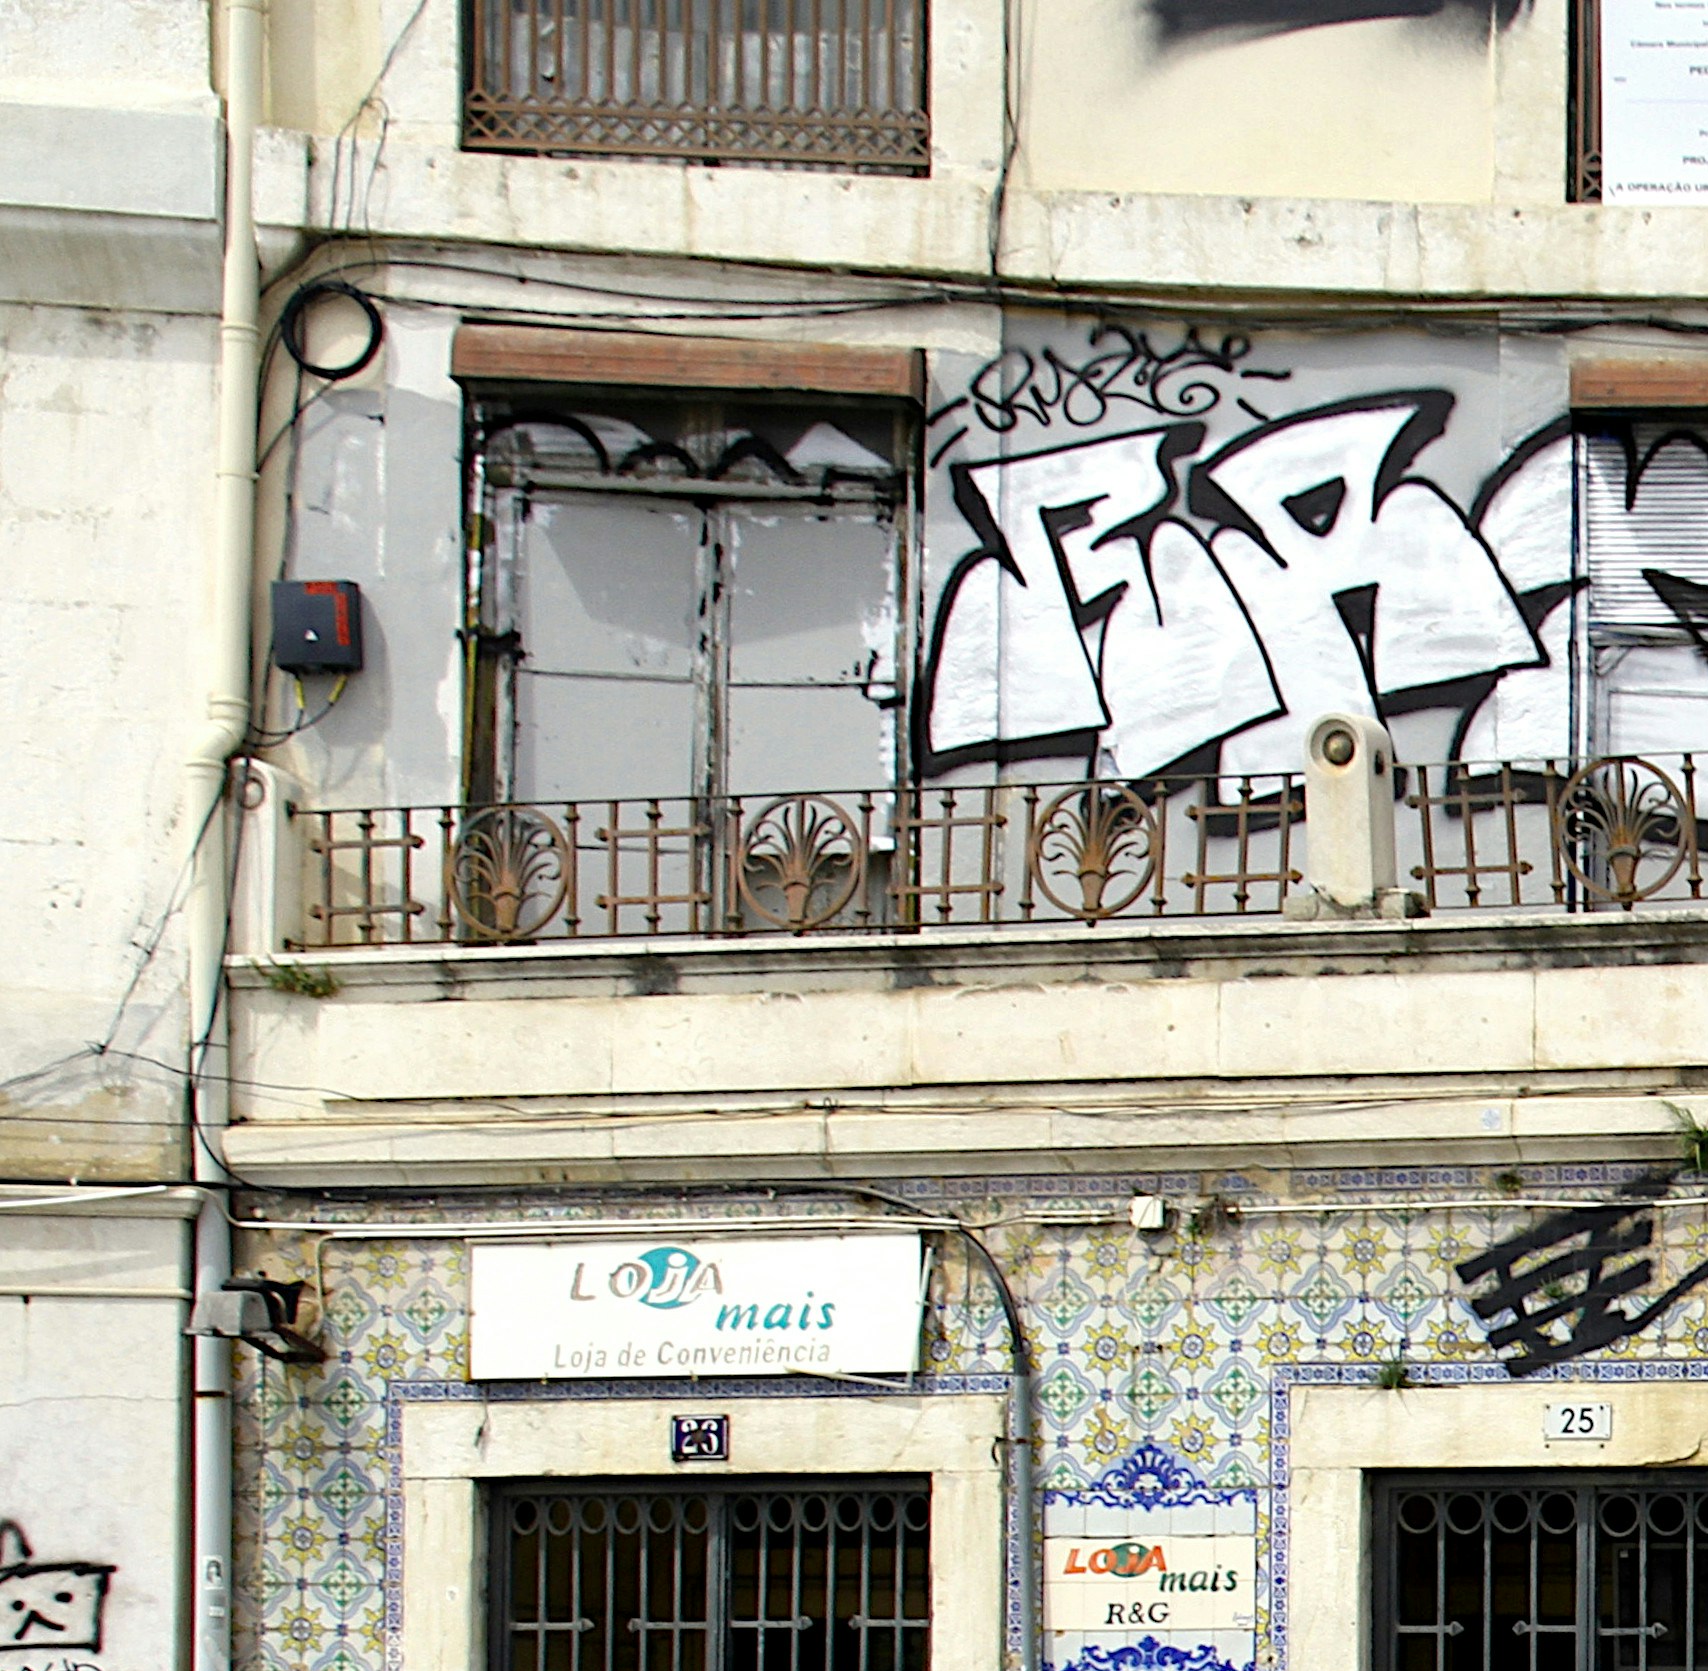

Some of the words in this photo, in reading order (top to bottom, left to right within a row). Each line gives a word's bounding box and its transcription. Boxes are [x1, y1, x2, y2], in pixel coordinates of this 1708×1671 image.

[1627, 180, 1691, 194] OPERAÇÃO
[714, 1290, 837, 1332] mais
[555, 1343, 608, 1373] Loja
[617, 1341, 646, 1367] de
[657, 1337, 832, 1366] Conveniência
[1560, 1407, 1594, 1434] 25
[1159, 1563, 1239, 1593] mais
[1104, 1602, 1170, 1625] R&G
